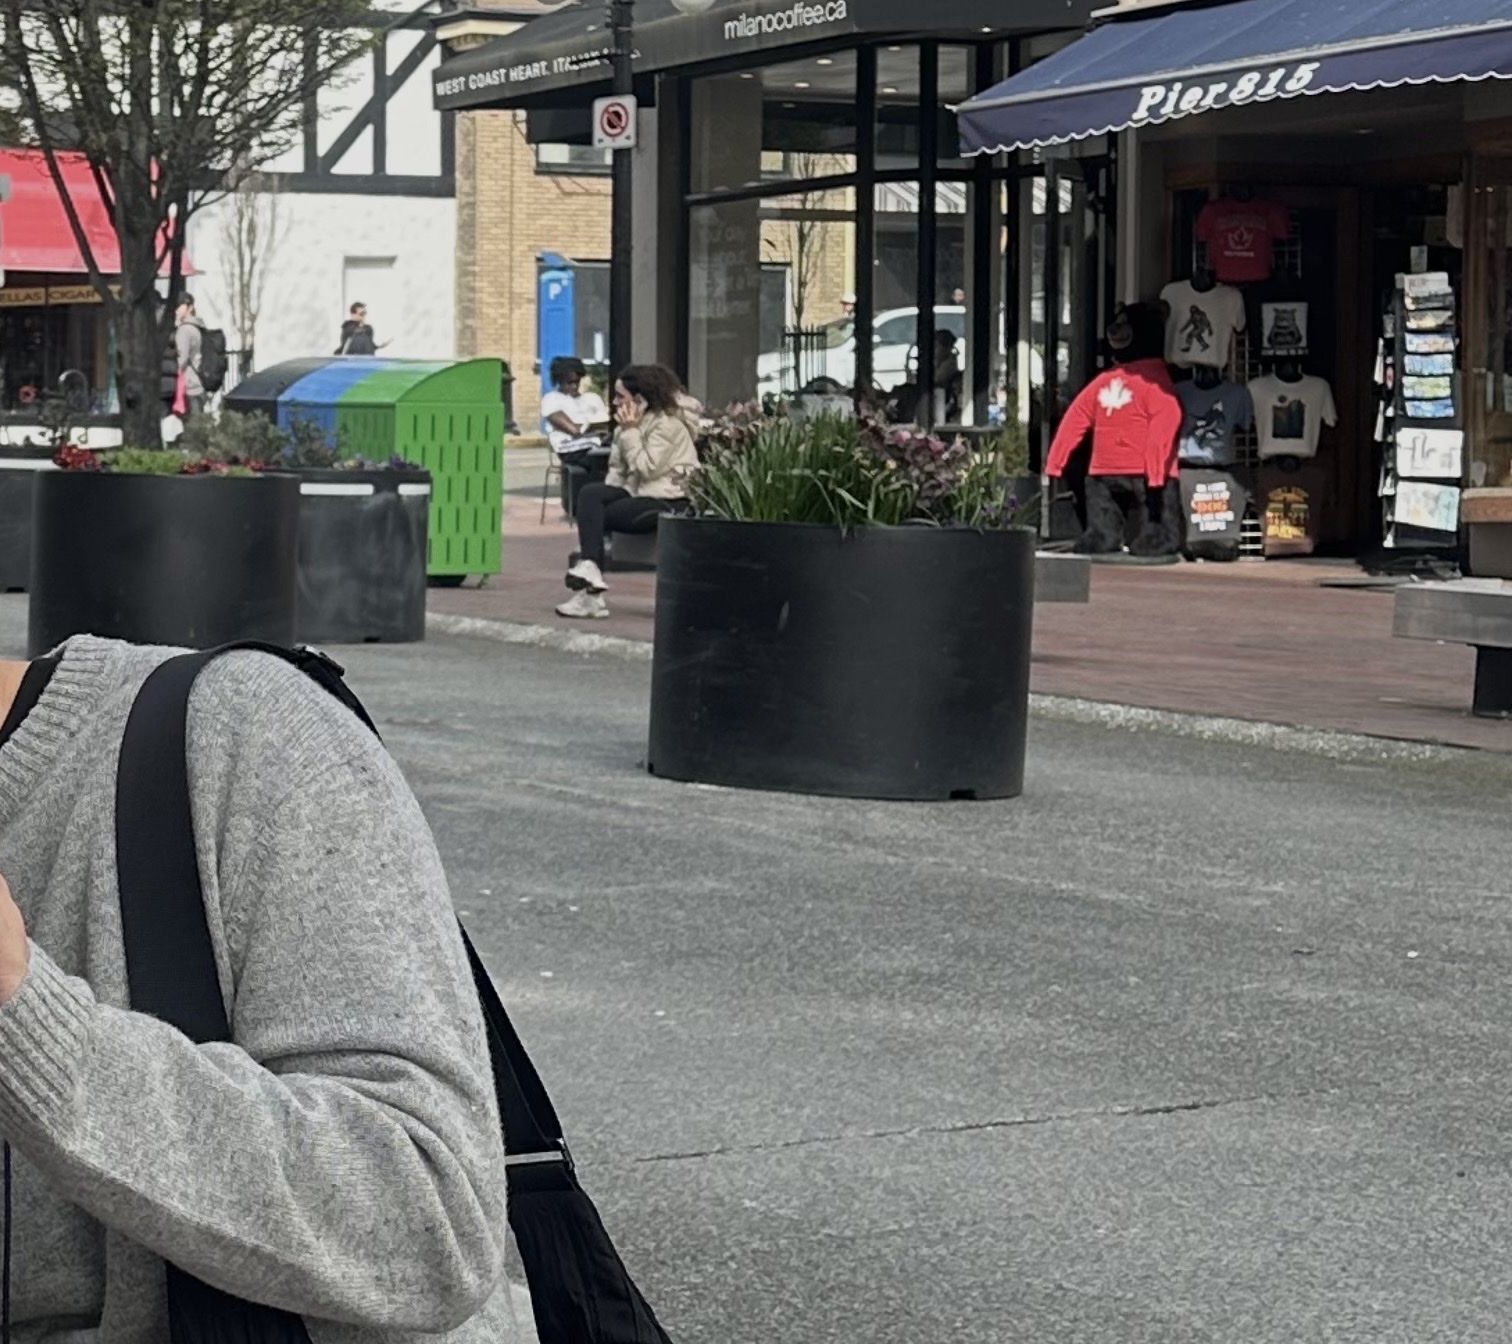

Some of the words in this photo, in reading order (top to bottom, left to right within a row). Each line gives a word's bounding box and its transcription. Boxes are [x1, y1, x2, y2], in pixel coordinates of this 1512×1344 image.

[724, 0, 847, 40] milanocoffee.ca
[435, 76, 466, 96] WEST
[468, 67, 507, 90] COAST
[1131, 82, 1228, 120] Pier
[1229, 61, 1321, 101] 815
